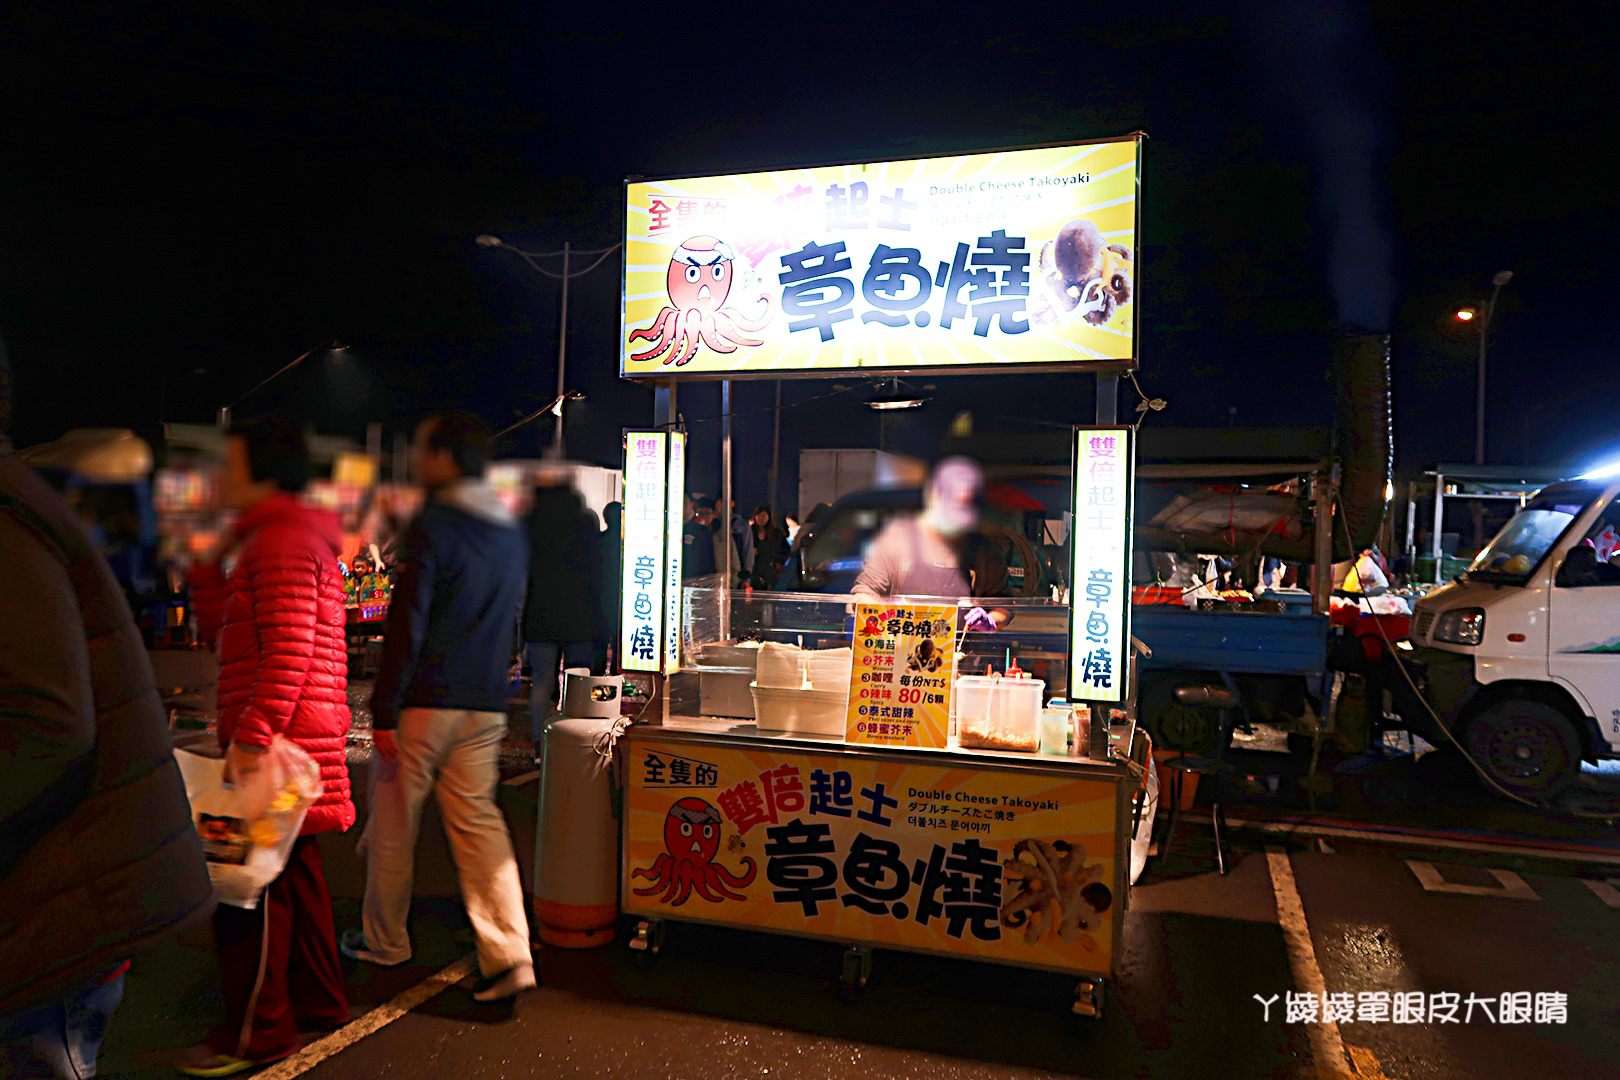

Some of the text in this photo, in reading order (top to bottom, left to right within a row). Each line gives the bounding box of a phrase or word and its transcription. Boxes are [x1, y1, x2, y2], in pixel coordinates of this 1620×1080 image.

[930, 172, 1090, 196] Double Cheese Takoyaki
[648, 199, 727, 231] 全隻的
[778, 229, 1031, 343] 章魚燒
[631, 555, 655, 660] 章魚燒
[887, 619, 932, 638] 章魚燒
[1082, 568, 1112, 688] 章魚燒
[875, 639, 896, 650] 海苔
[873, 655, 895, 666] 芥末
[870, 689, 892, 700] 辣味
[869, 706, 914, 718] 泰式甜辣
[867, 723, 912, 735] 蜂蜜芥末
[643, 753, 718, 786] 全隻的
[716, 762, 899, 837] 雙倍起士
[908, 787, 1059, 811] Double Cheese Takoyaki
[908, 801, 1015, 821] ダブルチーズたこ焼き
[764, 820, 1004, 941] 章魚燒
